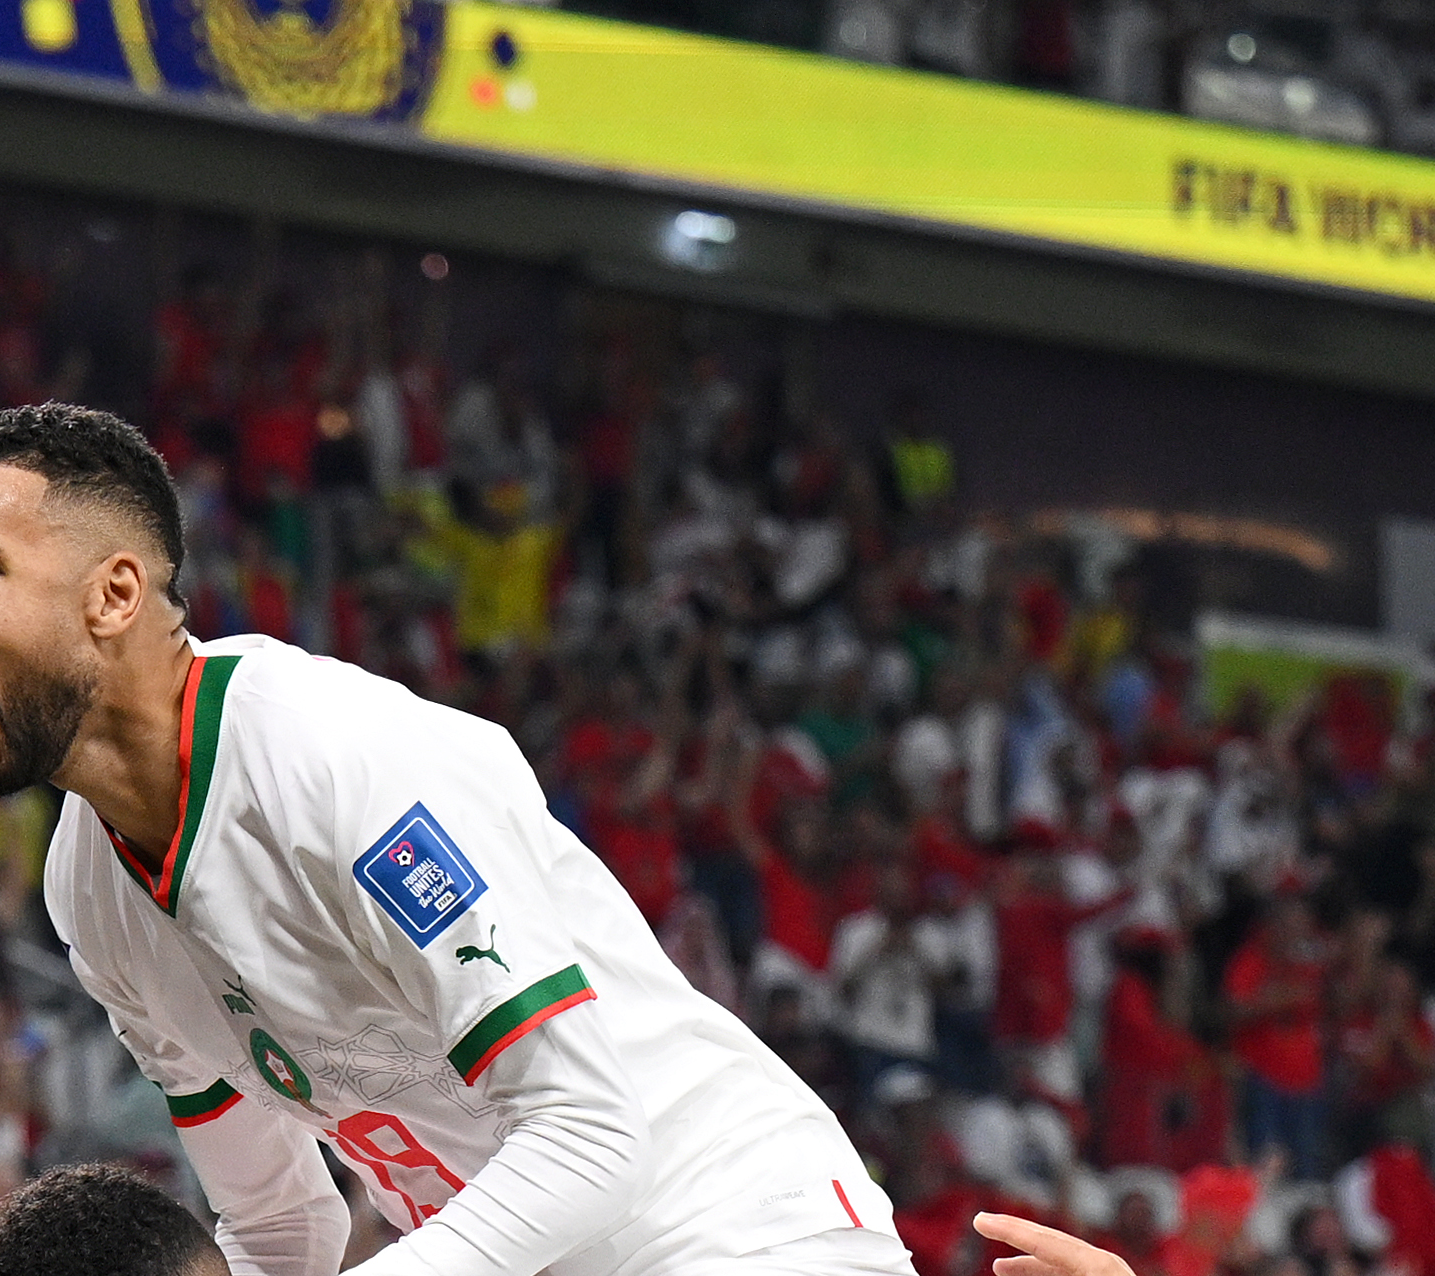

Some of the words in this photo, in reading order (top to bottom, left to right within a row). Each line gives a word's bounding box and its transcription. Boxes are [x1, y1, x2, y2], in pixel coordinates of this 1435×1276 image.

[1172, 157, 1297, 234] FIFA
[402, 857, 436, 888] FOOTBALL
[409, 864, 444, 898] UNITES
[429, 872, 455, 898] World
[437, 894, 452, 908] FIFA
